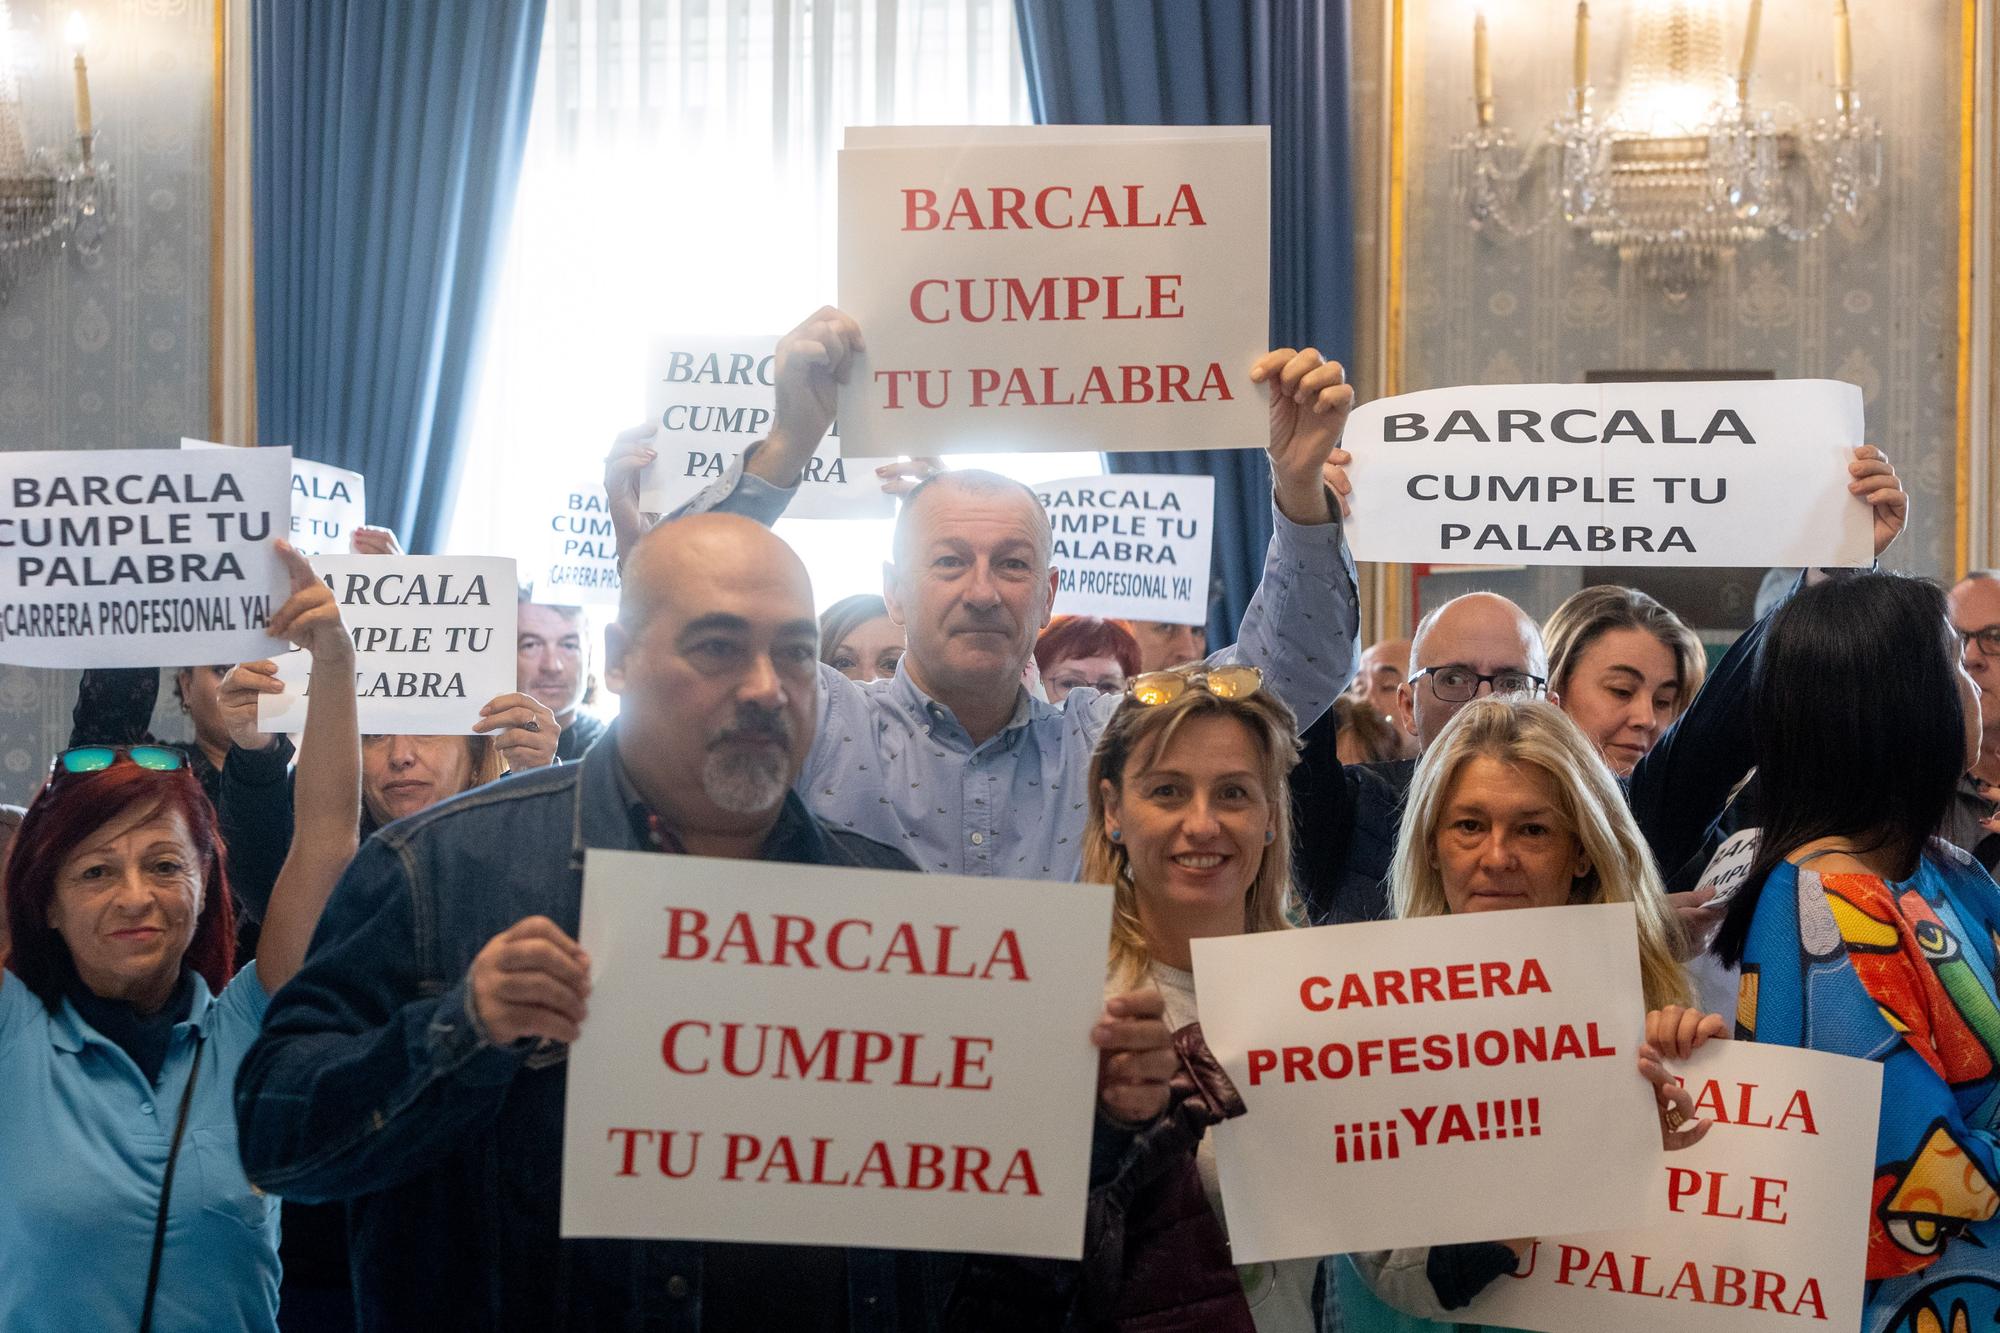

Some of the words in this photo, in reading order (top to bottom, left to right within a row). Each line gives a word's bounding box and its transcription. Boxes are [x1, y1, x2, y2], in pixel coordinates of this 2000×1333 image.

[900, 183, 1207, 231] BARCALA
[910, 274, 1185, 324] CUMPLE
[874, 369, 951, 409] TU
[968, 362, 1234, 407] PALABRA
[1383, 409, 1757, 444] BARCALA
[13, 473, 244, 508] BARCALA
[1038, 489, 1181, 511] BARCALA
[1406, 474, 1635, 503] CUMPLE
[1653, 477, 1726, 504] TU
[207, 511, 270, 542] TU
[308, 518, 339, 538] TU
[1157, 517, 1197, 540] TU
[1440, 523, 1697, 552] PALABRA
[18, 552, 245, 587] PALABRA
[1052, 540, 1177, 565] ALABRA
[1079, 570, 1168, 599] PROFESIONAL
[1172, 576, 1192, 601] YA!
[99, 596, 236, 635] PROFESIONAL
[241, 594, 271, 630] YA!
[445, 627, 494, 652] TU
[660, 907, 1030, 982] BARCALA
[1299, 958, 1552, 1012] CARRERA
[661, 1019, 994, 1092] CUMPLE
[1247, 1022, 1616, 1086] PROFESIONAL
[1673, 1076, 1820, 1135] ALA
[1334, 1097, 1541, 1163] ¡¡¡¡YA!!!!
[607, 1127, 703, 1179] TU
[719, 1133, 1043, 1197] PALABRA
[1554, 1243, 1828, 1320] PALABRA
